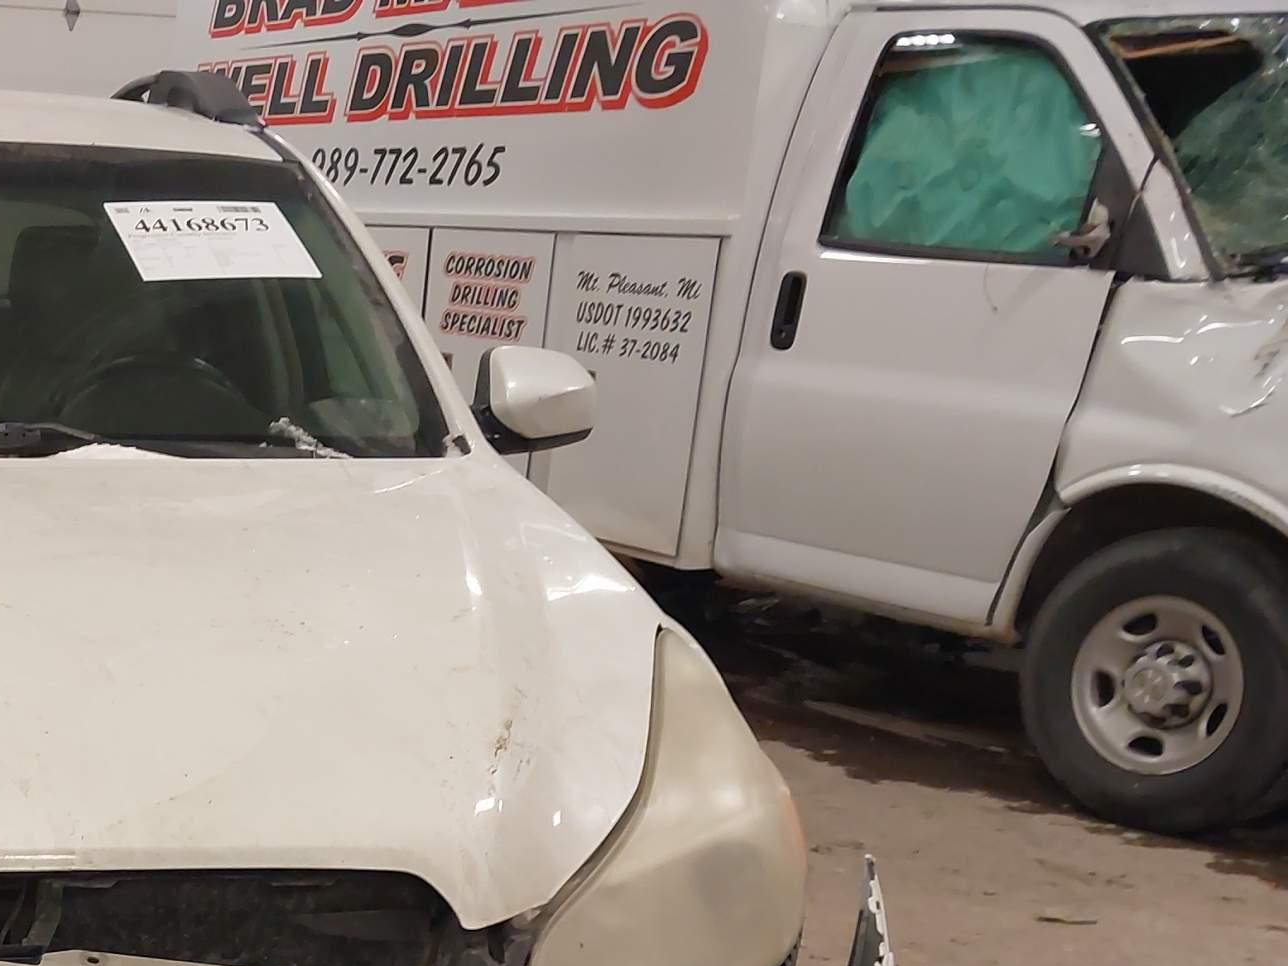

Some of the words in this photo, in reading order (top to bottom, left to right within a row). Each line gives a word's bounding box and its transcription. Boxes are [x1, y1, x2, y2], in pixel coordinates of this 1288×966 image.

[210, 0, 363, 38] BR
[345, 14, 708, 122] DRILLING
[135, 217, 270, 233] 44168673
[445, 254, 533, 280] CORROSION
[451, 283, 519, 309] DRILLING
[441, 311, 525, 339] SPECIALIST
[576, 301, 624, 326] USDOT
[624, 305, 692, 333] 1993632
[619, 337, 680, 364] 37-2084
